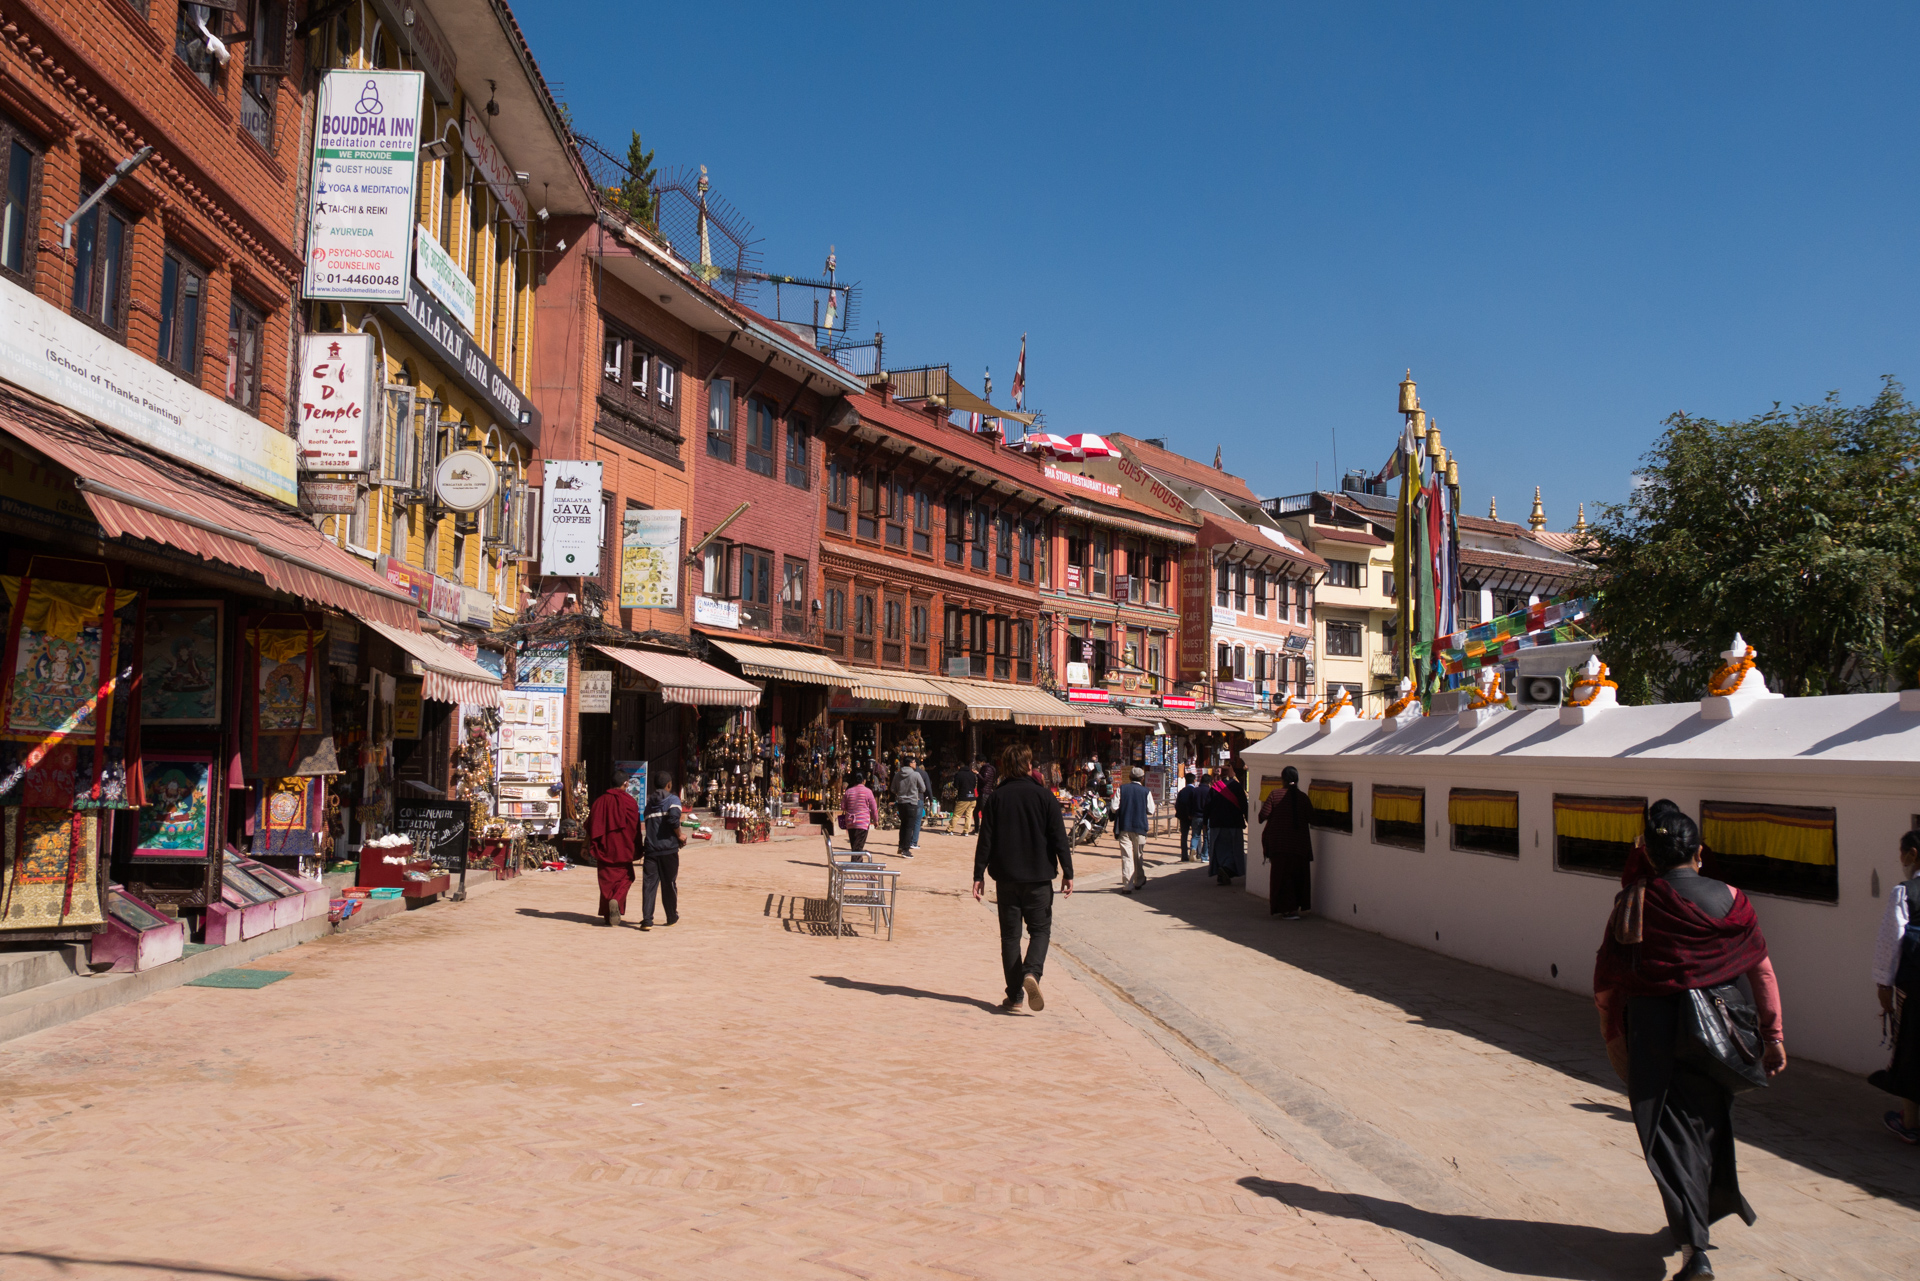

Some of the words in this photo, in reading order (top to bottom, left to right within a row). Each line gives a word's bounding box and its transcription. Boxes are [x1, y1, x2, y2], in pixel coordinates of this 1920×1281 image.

[322, 115, 386, 136] BOUDDHA
[390, 118, 414, 137] INN
[321, 137, 377, 149] meditation
[379, 140, 413, 150] centre
[339, 150, 353, 159] WE
[354, 151, 392, 160] PROVIDE
[335, 164, 362, 175] GUEST
[364, 165, 393, 175] HOUSE
[328, 184, 351, 194] YOGA
[352, 185, 359, 194] &
[361, 185, 409, 195] MEDITATION
[328, 204, 357, 214] TAI-CHI
[358, 205, 365, 215] &
[366, 205, 388, 215] REIKI
[330, 227, 374, 237] AYURVEDA
[328, 248, 395, 259] PSYCHO-SOCIAL
[327, 260, 381, 271] COUNSELING
[327, 273, 399, 286] 01-4460048
[45, 347, 87, 379] (School
[90, 363, 101, 385] of
[104, 378, 140, 405] Thanka
[142, 396, 182, 427] Painting)
[466, 348, 488, 389] JAVA
[492, 374, 520, 420] COFFEE
[65, 375, 104, 404] Retailer
[107, 400, 117, 411] of
[303, 401, 362, 423] Temple
[1056, 470, 1071, 484] STUPA
[1071, 474, 1102, 493] RESTAURANT
[1102, 483, 1106, 494] &
[1106, 485, 1119, 498] CAFE
[1118, 457, 1150, 487] GUEST
[1150, 480, 1185, 514] HOUSE
[553, 504, 591, 514] JAVA
[552, 515, 591, 524] COFFEE
[1, 498, 68, 529] Wholesaler,
[125, 535, 160, 556] Tibetan,
[1183, 573, 1203, 583] STUPA
[1184, 612, 1200, 621] CAFE
[1183, 638, 1204, 649] GUEST
[1182, 653, 1204, 663] HOUSE
